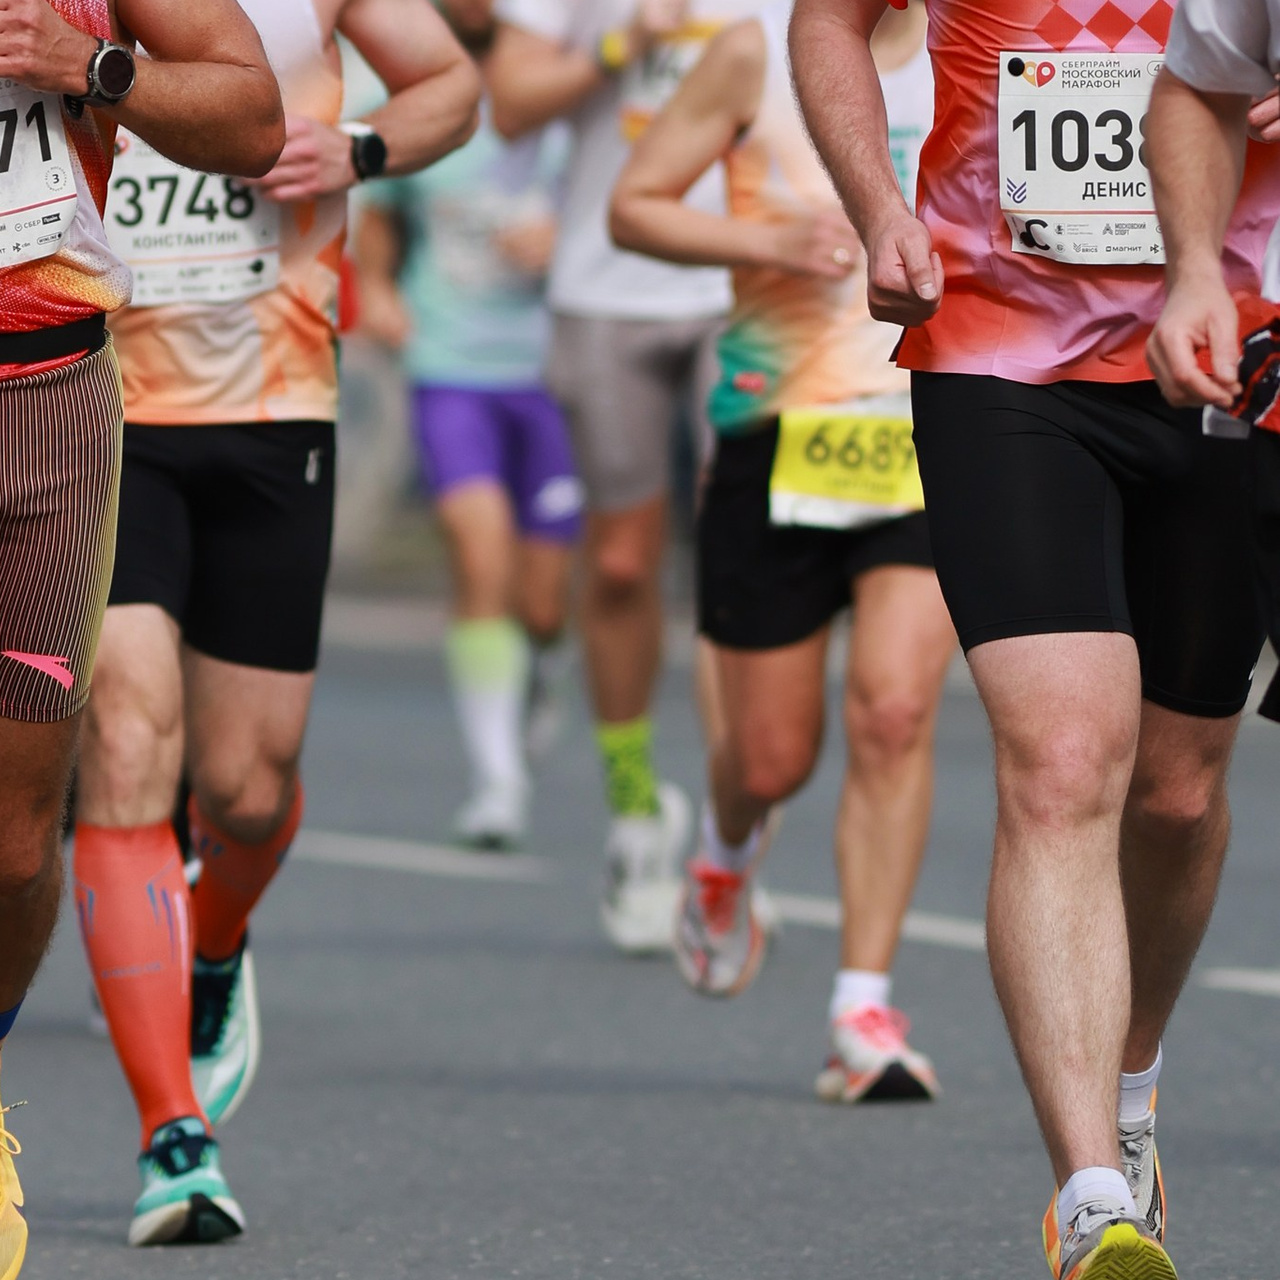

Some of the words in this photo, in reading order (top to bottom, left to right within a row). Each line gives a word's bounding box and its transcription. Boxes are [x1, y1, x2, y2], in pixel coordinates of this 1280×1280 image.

[1061, 59, 1120, 68] СБЕРПРАЙМ
[1061, 68, 1141, 78] МОСКОВСКИЙ
[1061, 79, 1121, 88] МАРАФОН
[52, 173, 60, 184] 3
[1082, 182, 1147, 200] ДЕНИС
[113, 175, 254, 226] 3748
[132, 231, 238, 249] КОНСТАНТИН
[805, 421, 914, 473] 6689
